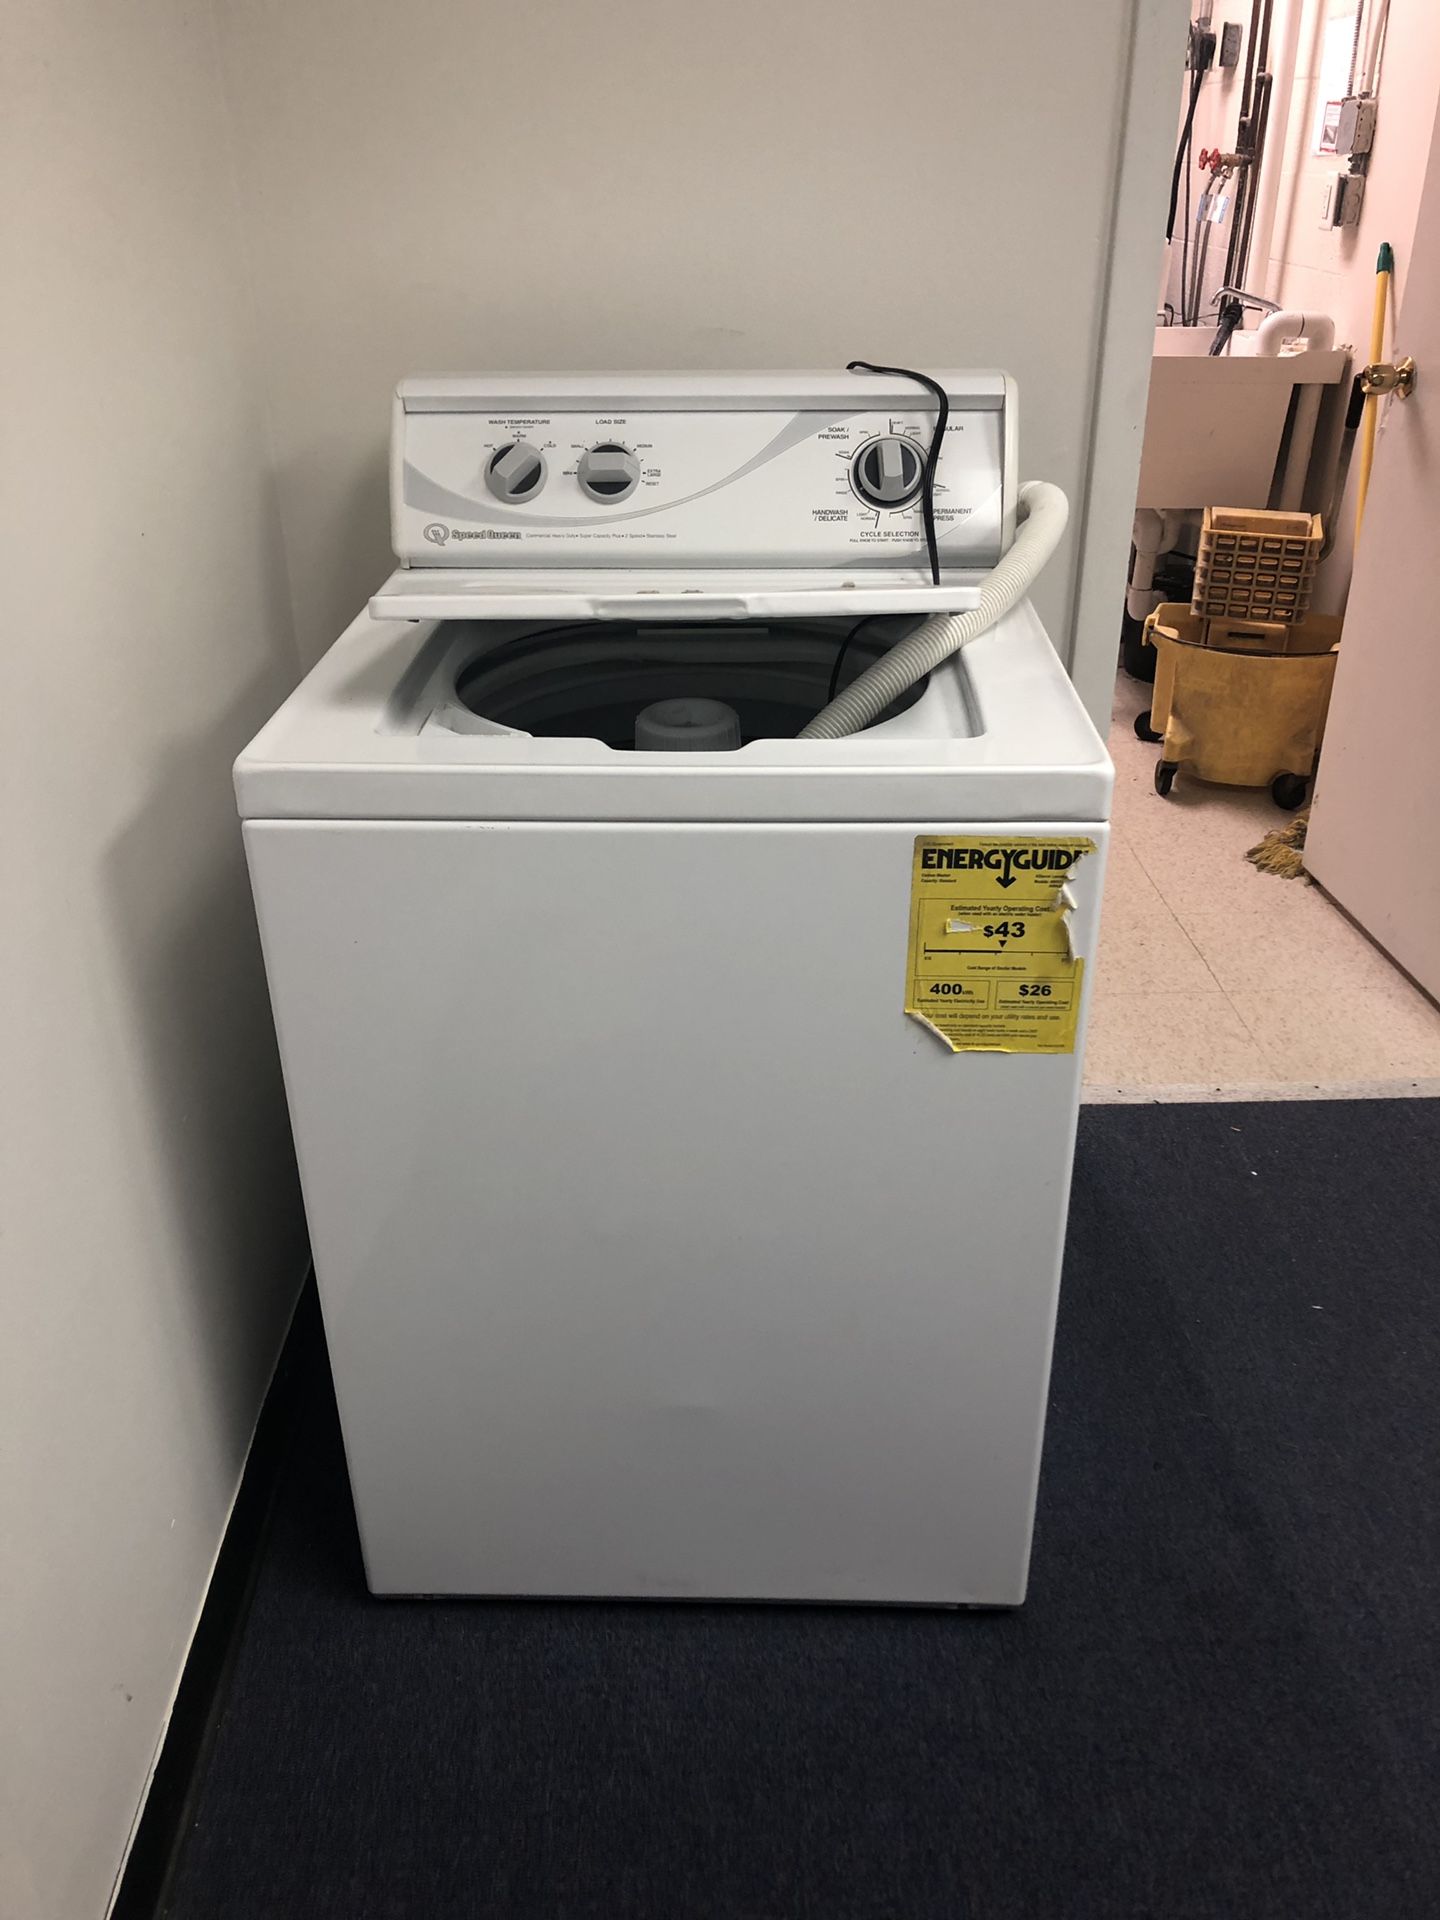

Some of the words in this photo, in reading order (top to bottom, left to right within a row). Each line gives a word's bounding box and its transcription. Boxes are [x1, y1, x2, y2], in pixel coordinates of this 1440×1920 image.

[451, 529, 486, 541] Speed
[486, 529, 522, 541] Queen
[983, 905, 1002, 913] Yearly
[1003, 905, 1034, 913] Operating
[983, 921, 1026, 939] $43
[929, 983, 963, 995] 400
[1019, 984, 1052, 997] $26
